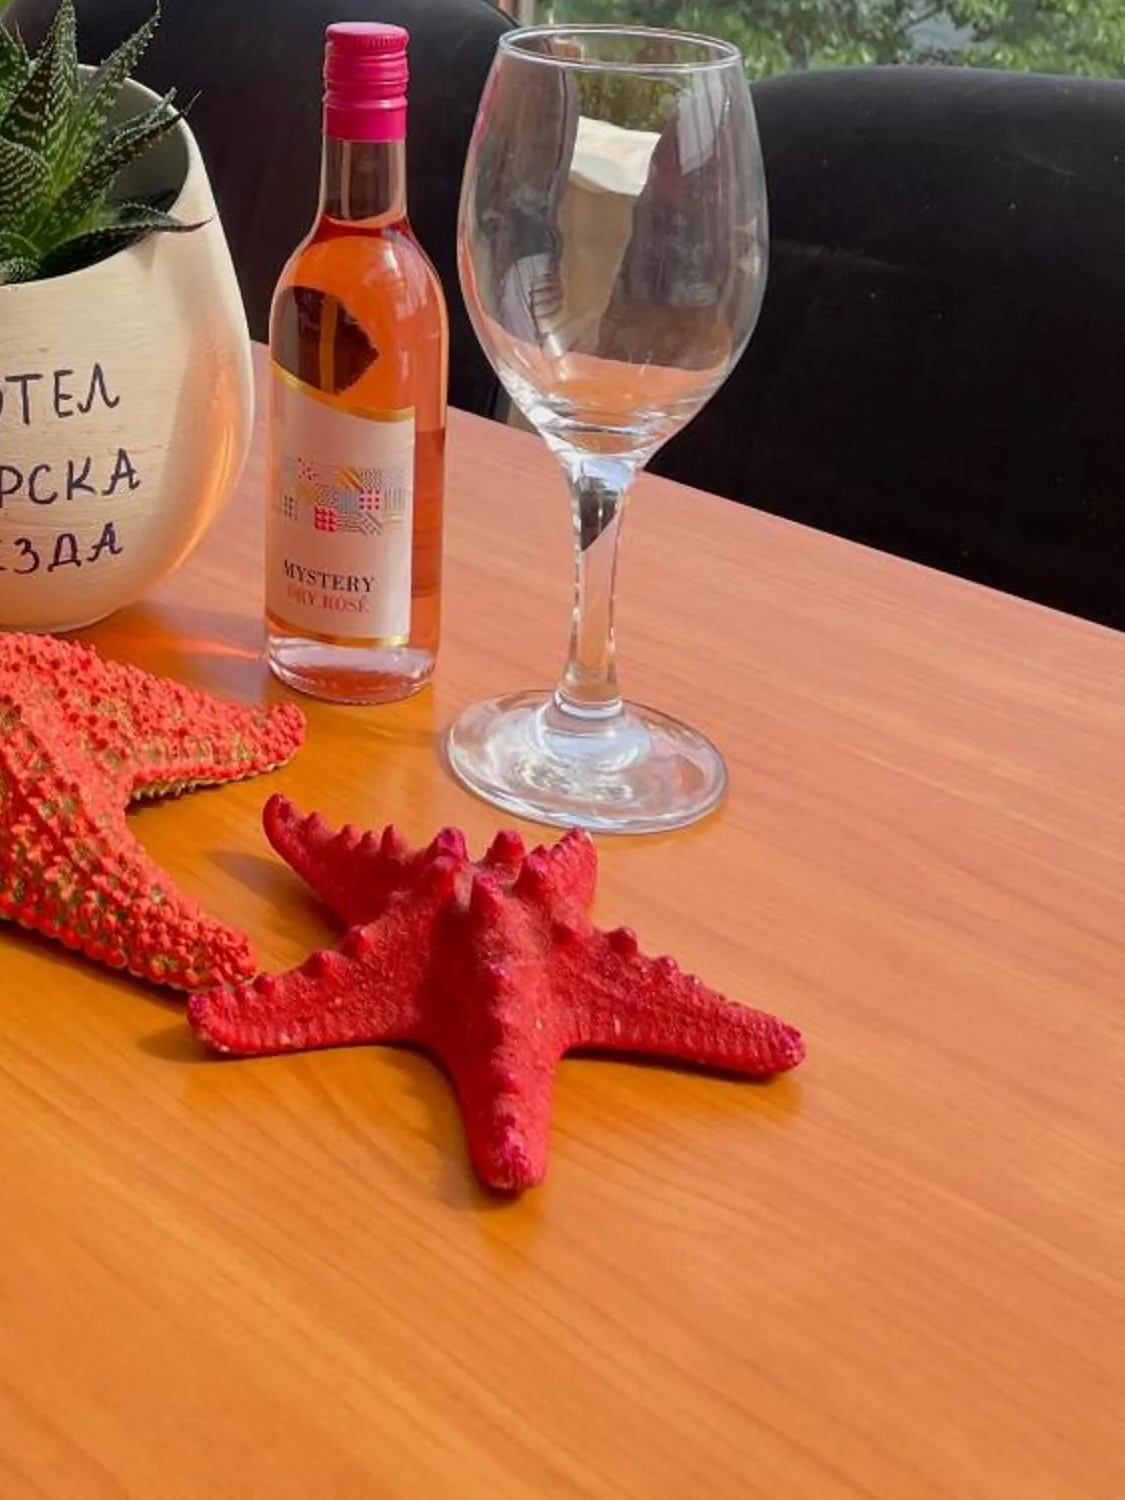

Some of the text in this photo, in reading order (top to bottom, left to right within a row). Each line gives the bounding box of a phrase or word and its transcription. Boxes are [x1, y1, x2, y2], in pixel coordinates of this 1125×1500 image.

[283, 559, 375, 592] MYSTERY
[287, 584, 370, 613] DRY ROSÉ
